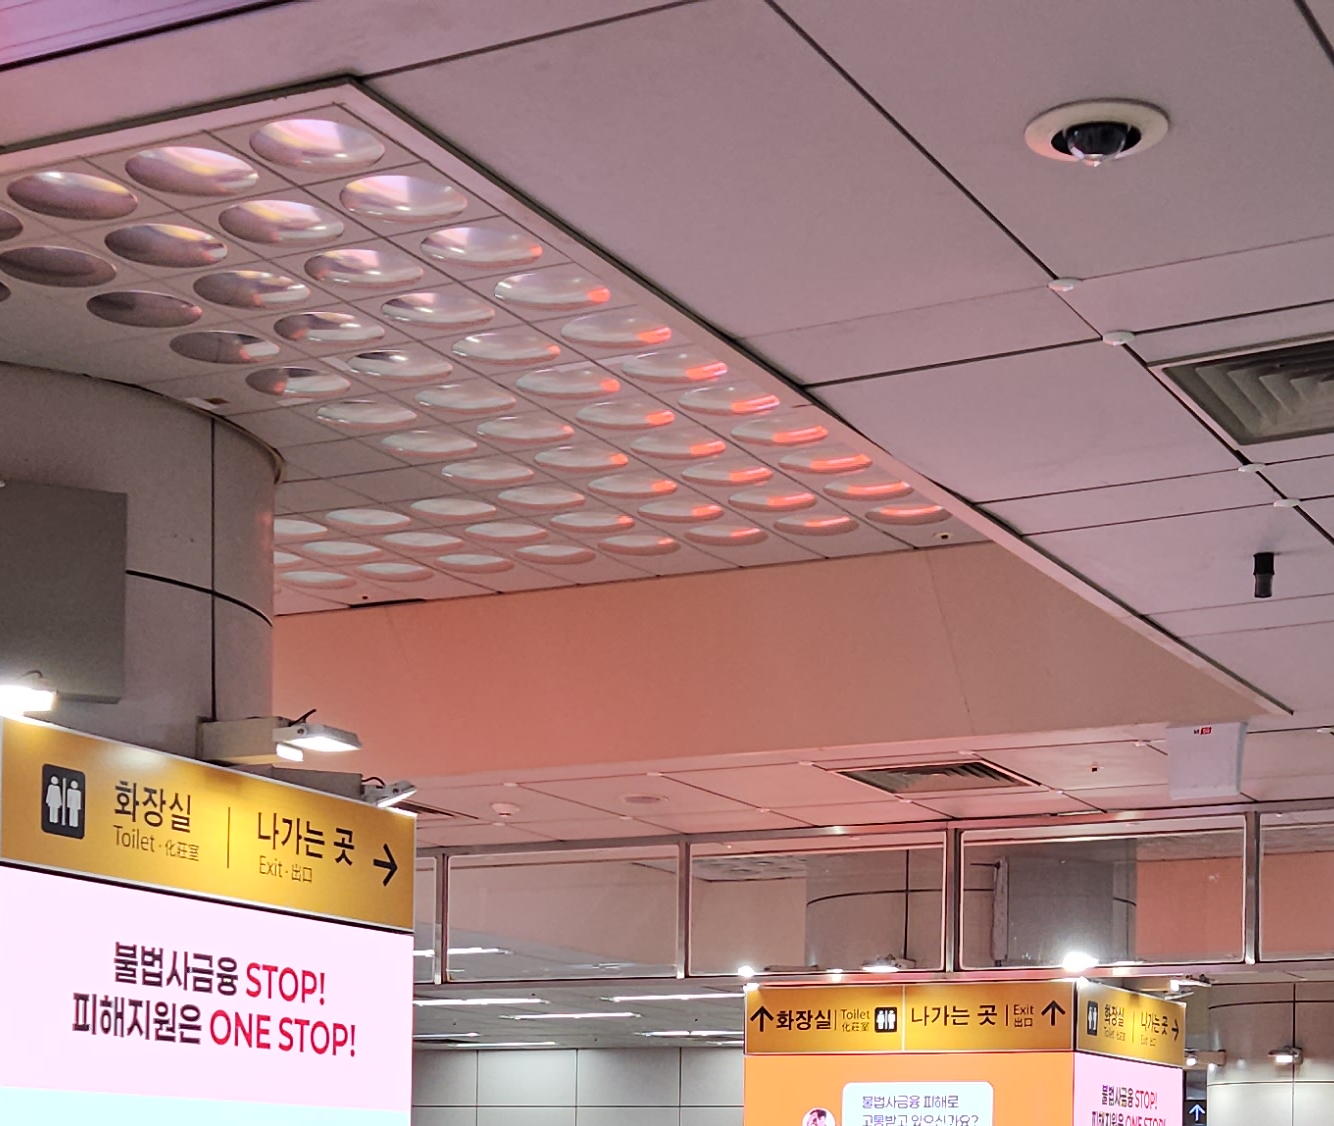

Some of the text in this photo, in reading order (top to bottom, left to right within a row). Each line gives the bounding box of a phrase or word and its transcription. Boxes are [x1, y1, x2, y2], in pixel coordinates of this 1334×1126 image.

[114, 779, 193, 834] 화장실
[113, 825, 156, 854] Toilet
[257, 811, 355, 866] 나가는 곳
[259, 855, 283, 878] Exit
[291, 863, 313, 883] 出口
[112, 941, 327, 1006] 불법사금융 STOP!
[775, 1008, 832, 1031] 화장실
[840, 1008, 871, 1021] Toilet
[911, 1004, 998, 1027] 나가는 곳
[1013, 1004, 1035, 1016] Exit
[1103, 1003, 1125, 1028] 화장실
[72, 992, 357, 1058] 피해지원은 ONE STOP!
[1140, 1010, 1169, 1036] 나가는 곳
[861, 1095, 959, 1109] 불법사금융 피해로
[1135, 1089, 1158, 1110] STOP!
